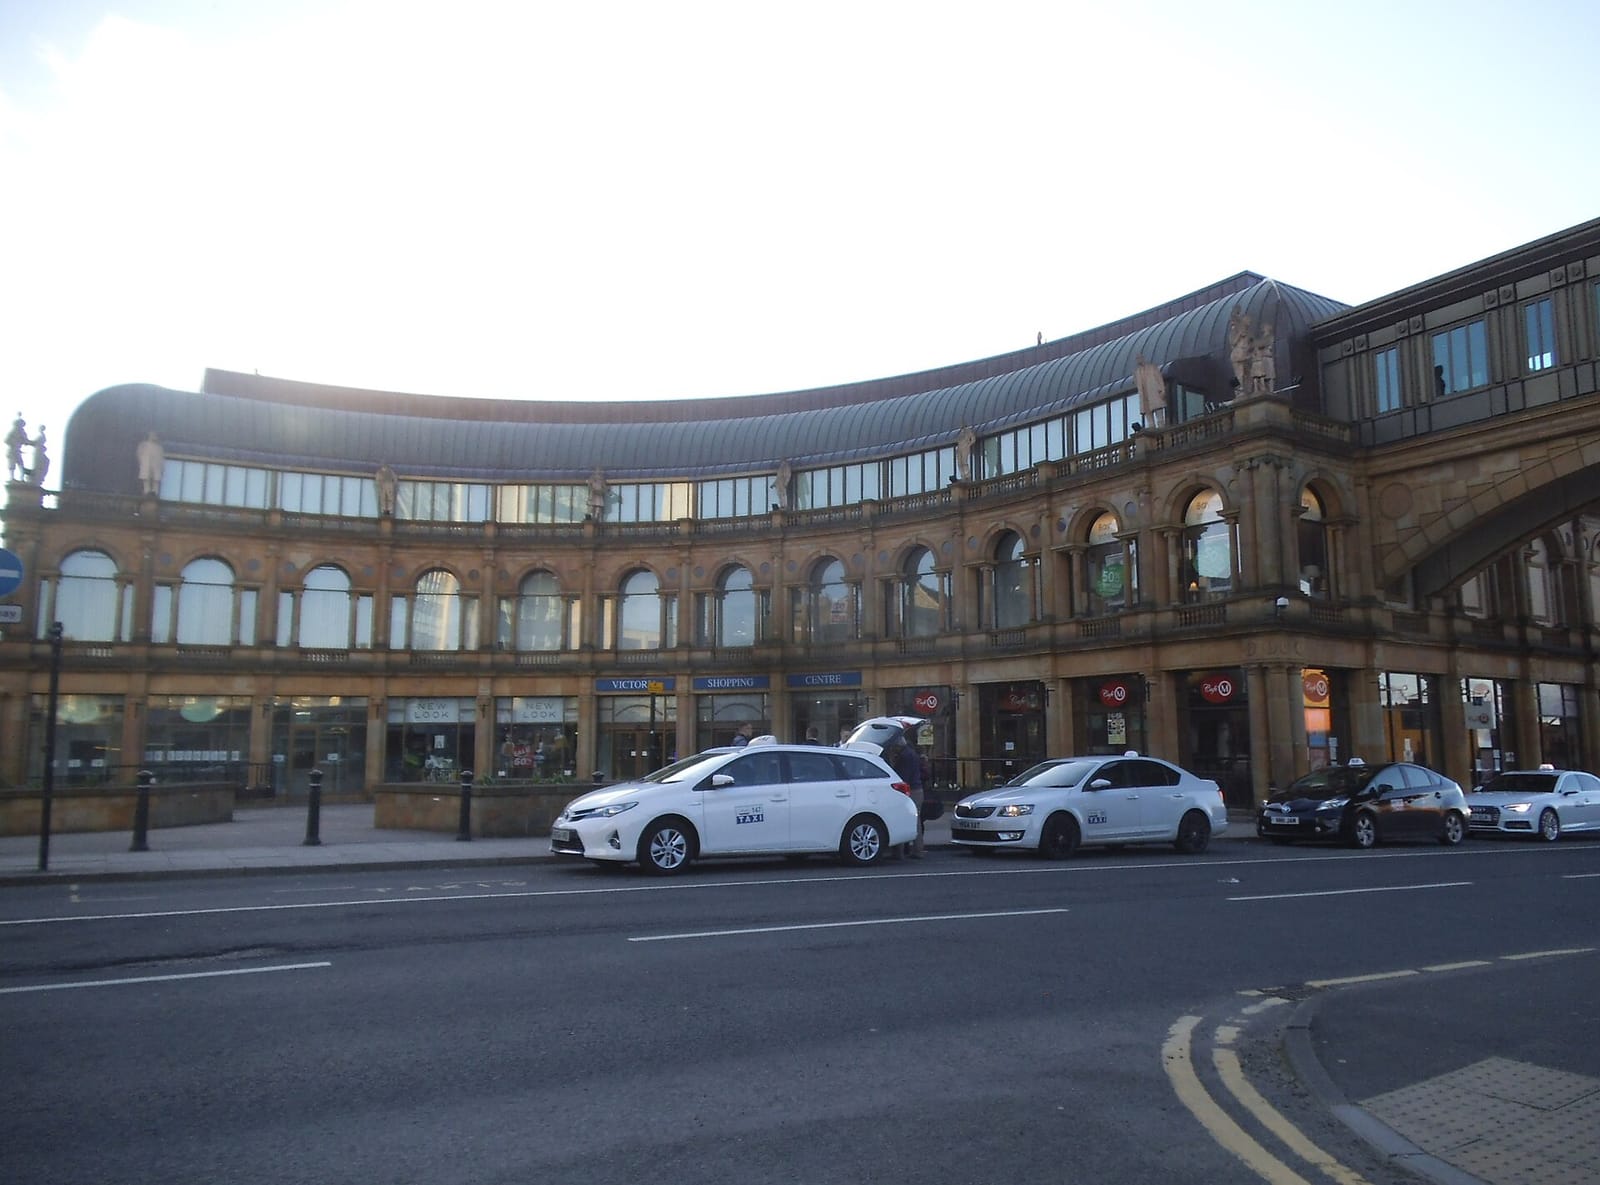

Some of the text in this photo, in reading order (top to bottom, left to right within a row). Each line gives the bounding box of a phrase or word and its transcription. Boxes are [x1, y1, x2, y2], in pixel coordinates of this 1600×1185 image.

[707, 677, 754, 688] SHOPPING
[805, 674, 841, 684] CENTRE
[612, 680, 658, 689] VICTOR
[526, 702, 554, 710] NEW
[739, 814, 763, 823] TAXI
[1089, 816, 1107, 824] TAXI
